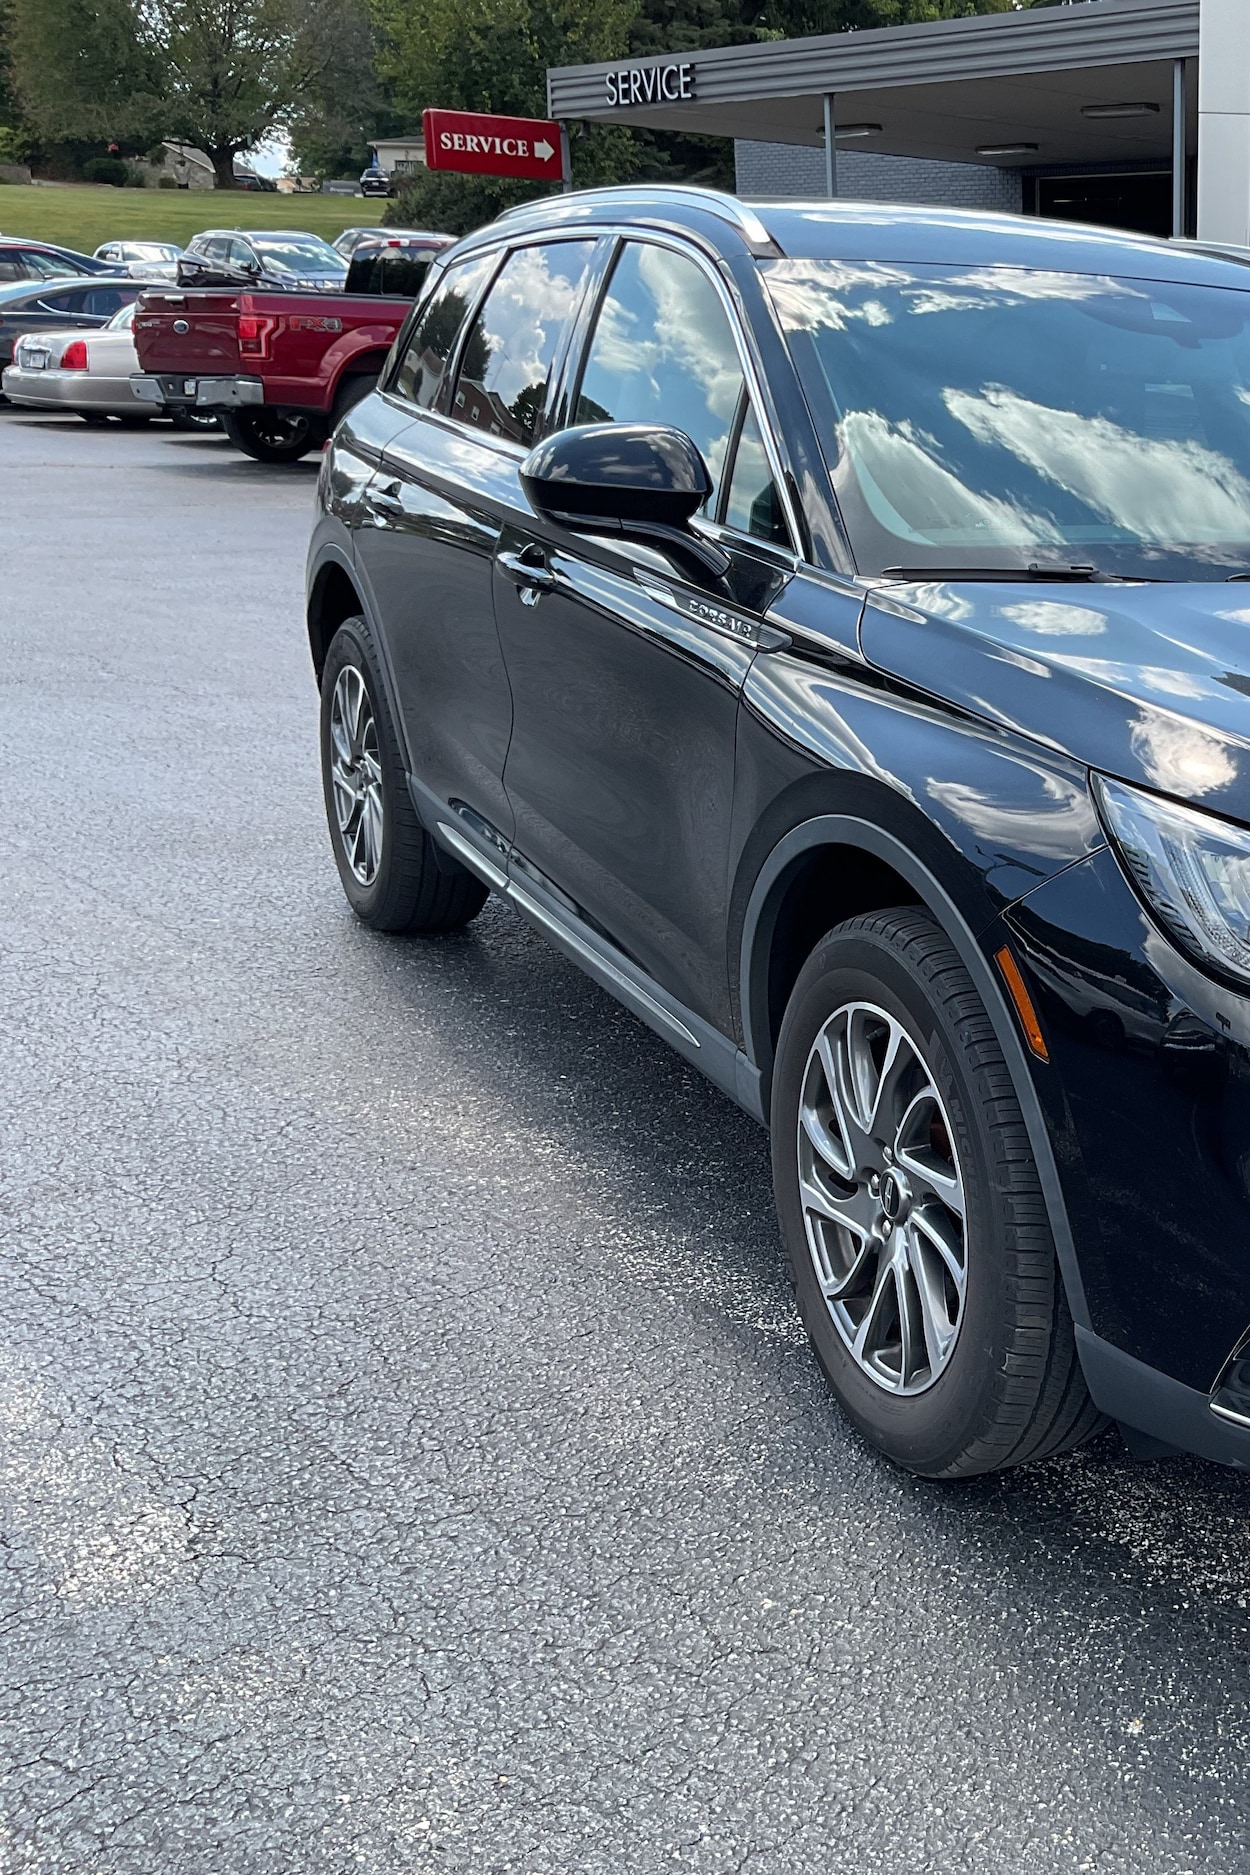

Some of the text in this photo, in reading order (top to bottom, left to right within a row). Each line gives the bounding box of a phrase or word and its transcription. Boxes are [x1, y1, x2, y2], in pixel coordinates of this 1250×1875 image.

[605, 63, 692, 106] SERVICE
[440, 132, 529, 157] SERVICE
[688, 599, 752, 638] CORSAIR
